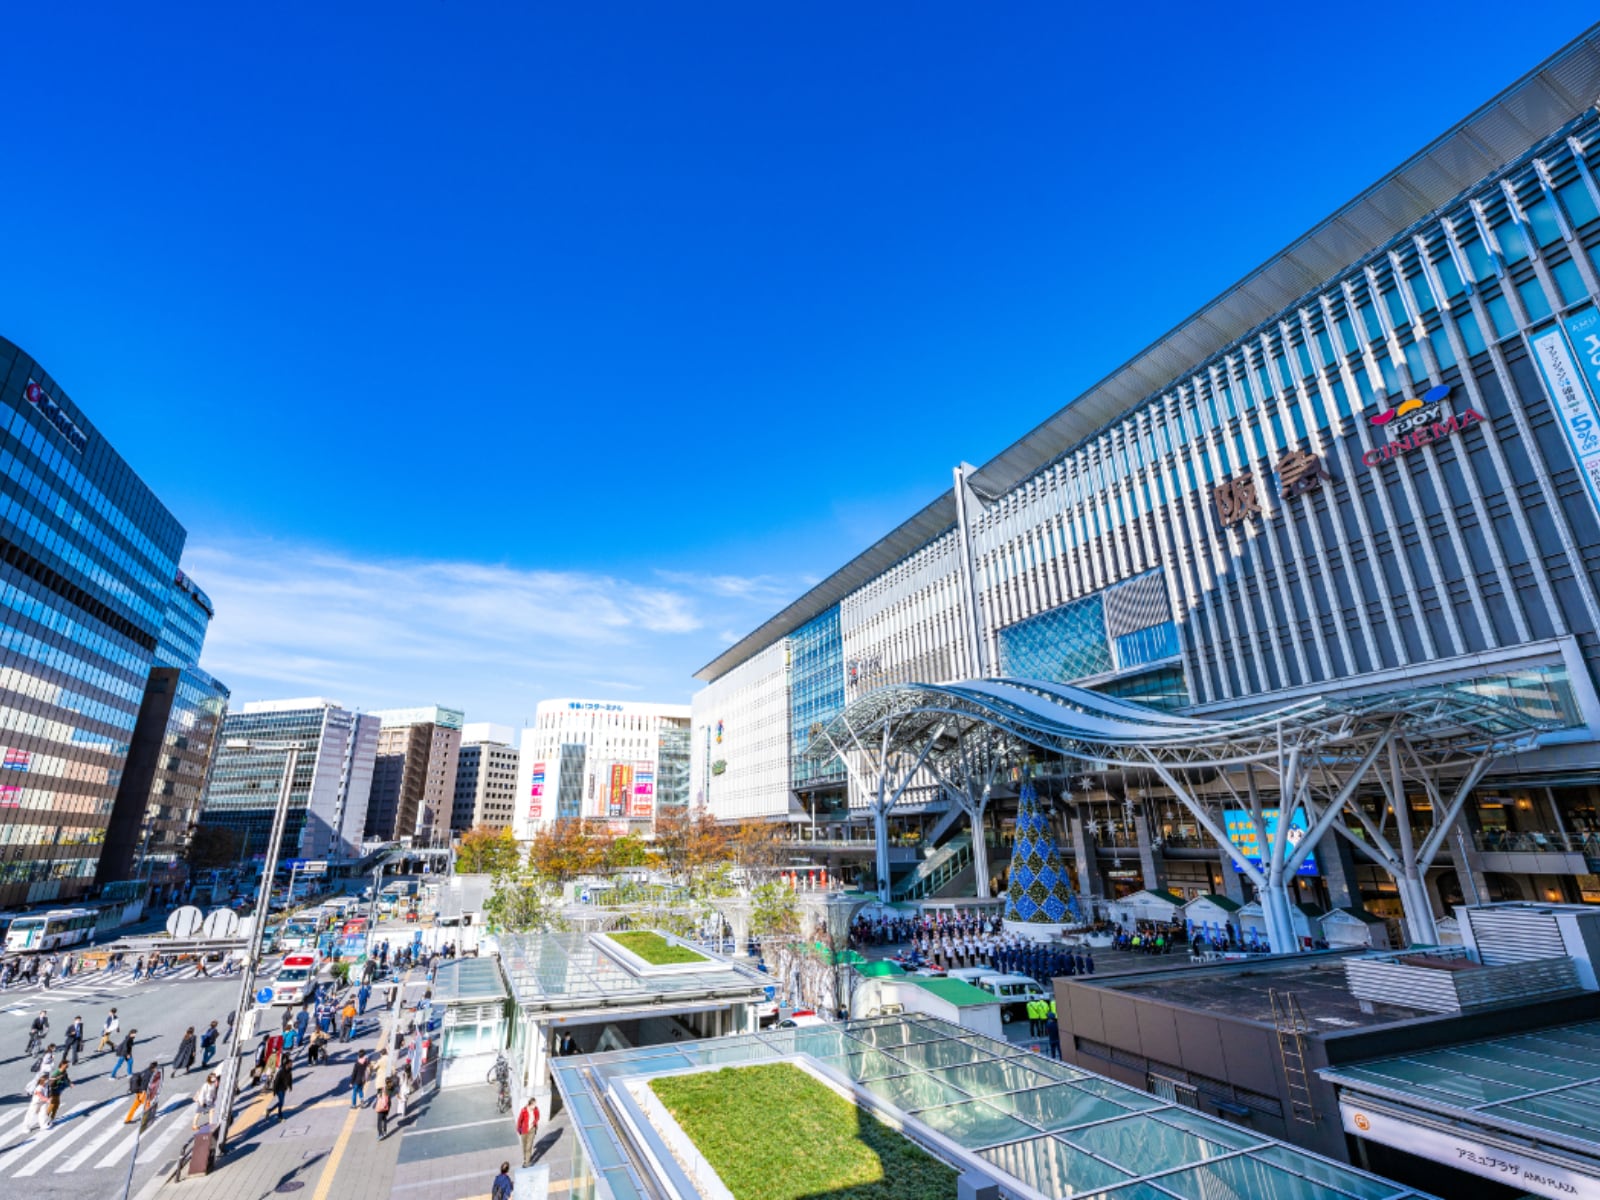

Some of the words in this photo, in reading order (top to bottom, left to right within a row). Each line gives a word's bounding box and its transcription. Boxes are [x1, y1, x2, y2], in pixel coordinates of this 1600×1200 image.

[1361, 407, 1484, 467] CINEMA
[1213, 449, 1331, 528] 阪急
[1455, 1146, 1521, 1176] アミュプラザ
